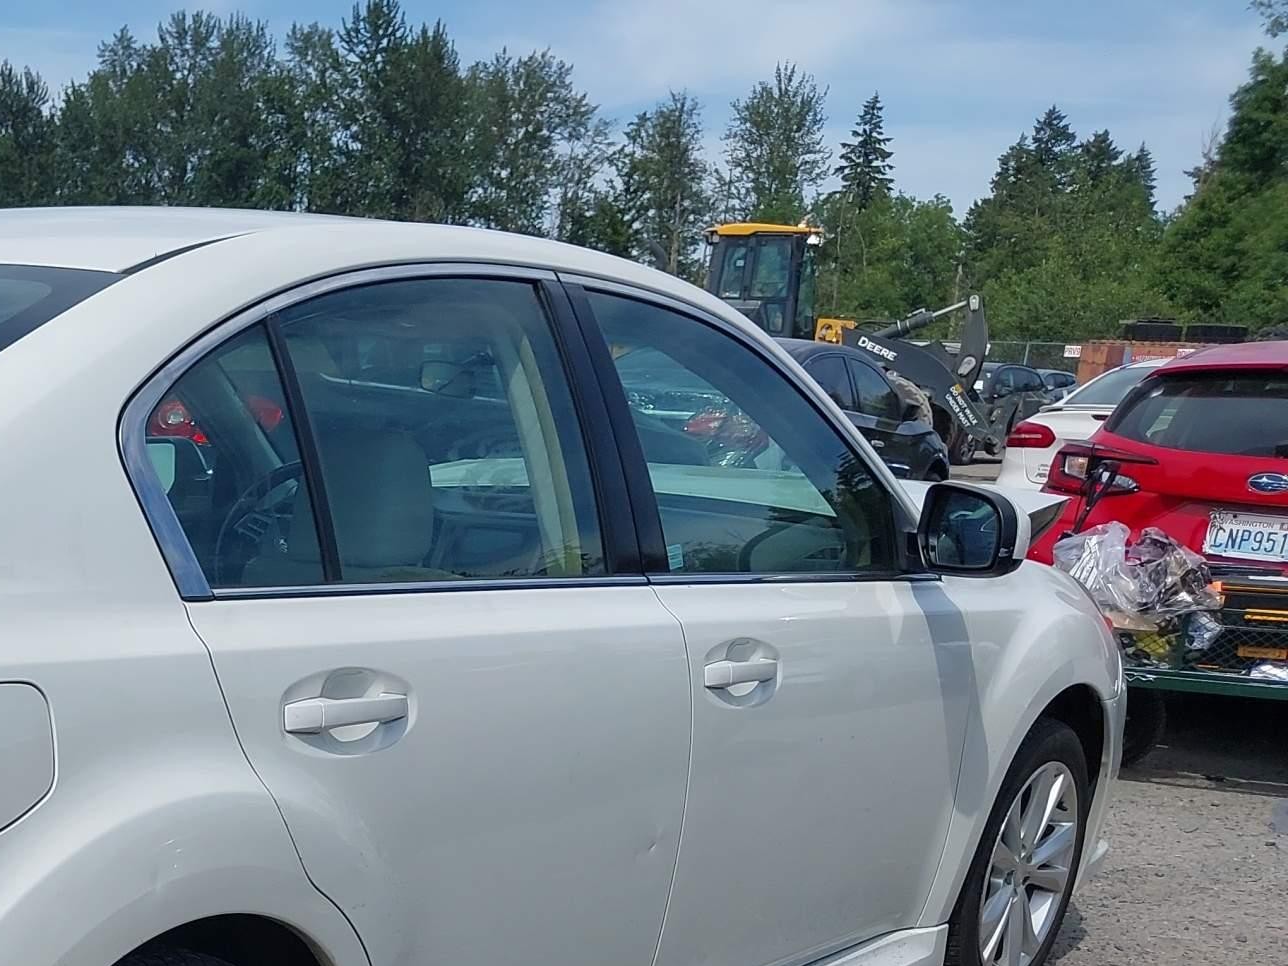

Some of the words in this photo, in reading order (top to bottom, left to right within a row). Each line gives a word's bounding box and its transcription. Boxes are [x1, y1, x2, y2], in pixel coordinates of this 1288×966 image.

[857, 336, 898, 361] DEERE
[945, 394, 960, 413] UNDER
[957, 412, 970, 427] MAST
[956, 395, 967, 408] NOT
[964, 408, 978, 425] WALK
[1222, 519, 1275, 529] WASHINGTON
[1210, 527, 1288, 554] CNP951
